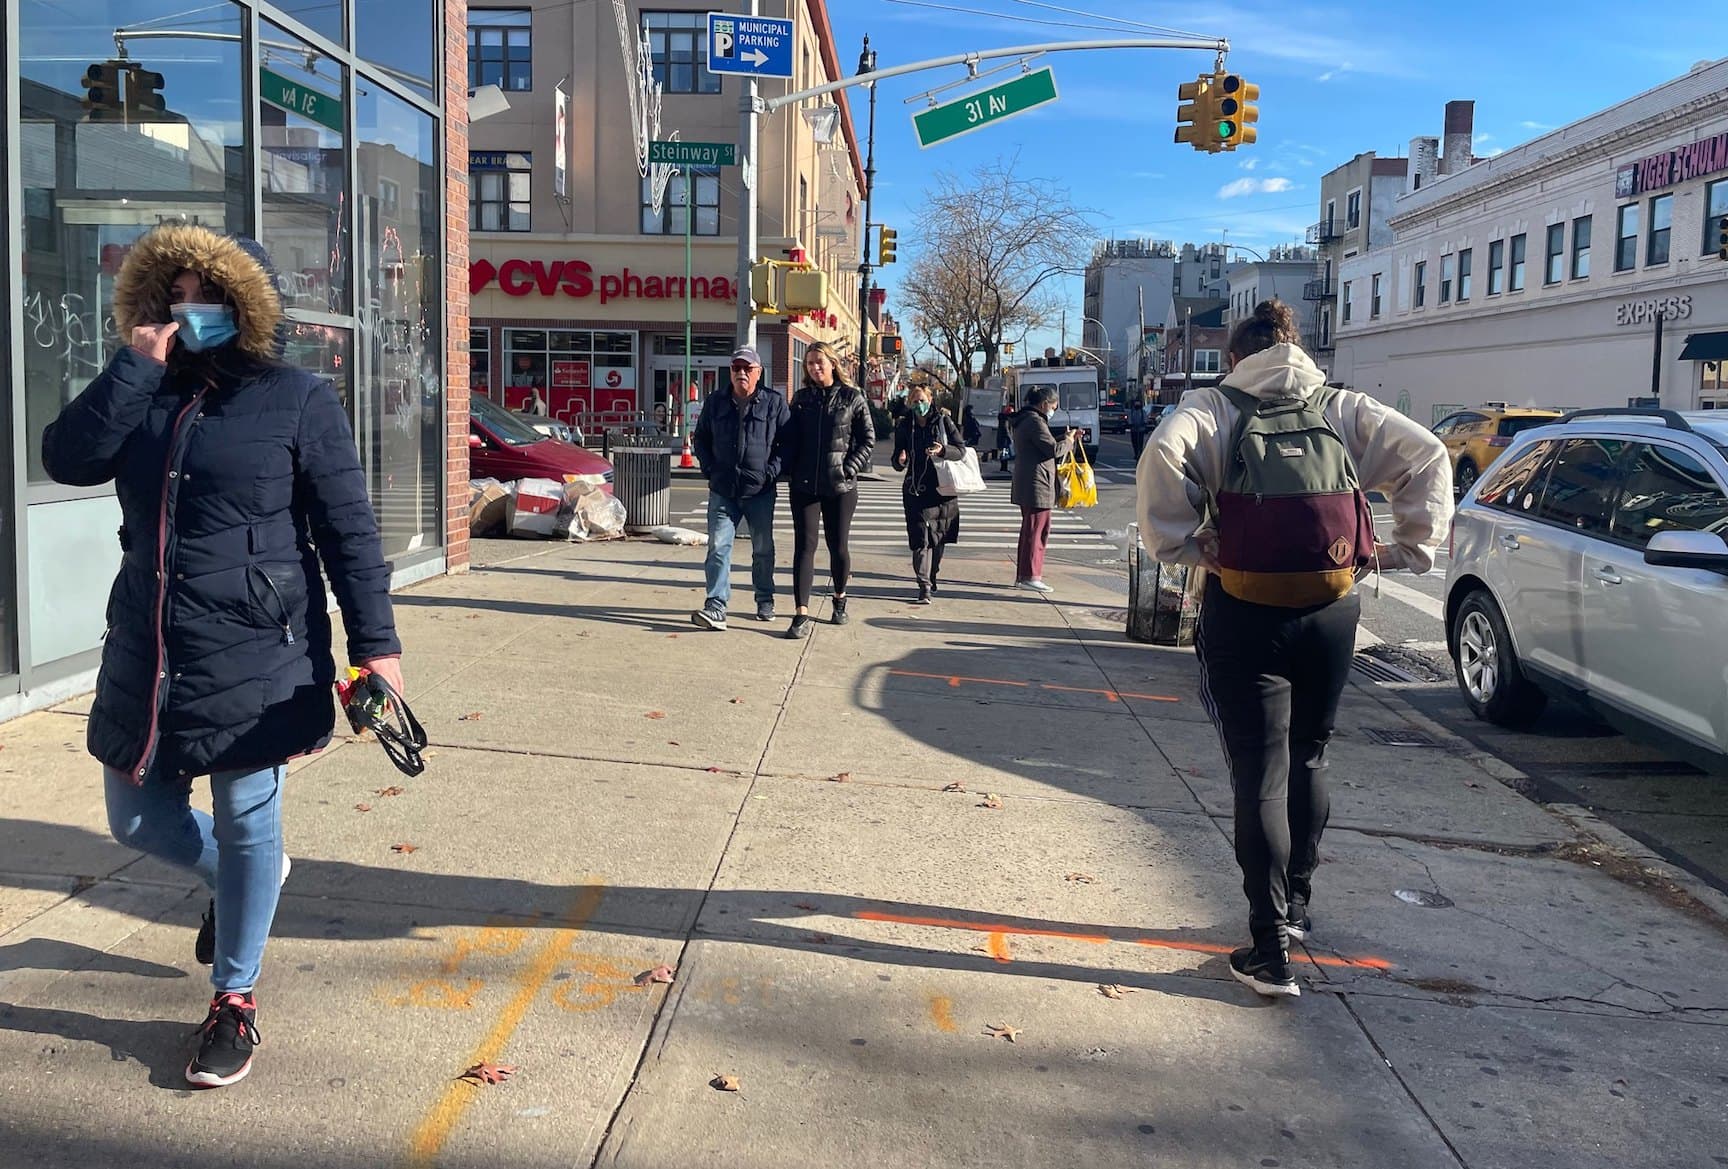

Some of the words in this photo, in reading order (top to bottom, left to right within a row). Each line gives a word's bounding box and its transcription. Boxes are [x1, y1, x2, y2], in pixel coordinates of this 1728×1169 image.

[739, 21, 788, 36] MUNICIPAL
[739, 34, 779, 47] PARKING
[715, 33, 733, 57] P
[965, 100, 984, 123] 31
[989, 94, 1007, 115] Av
[653, 143, 719, 166] Steinway
[1635, 152, 1671, 192] TIGER
[1673, 131, 1728, 183] SCHULM
[498, 259, 594, 297] CVS
[1616, 296, 1692, 325] EXPRESS
